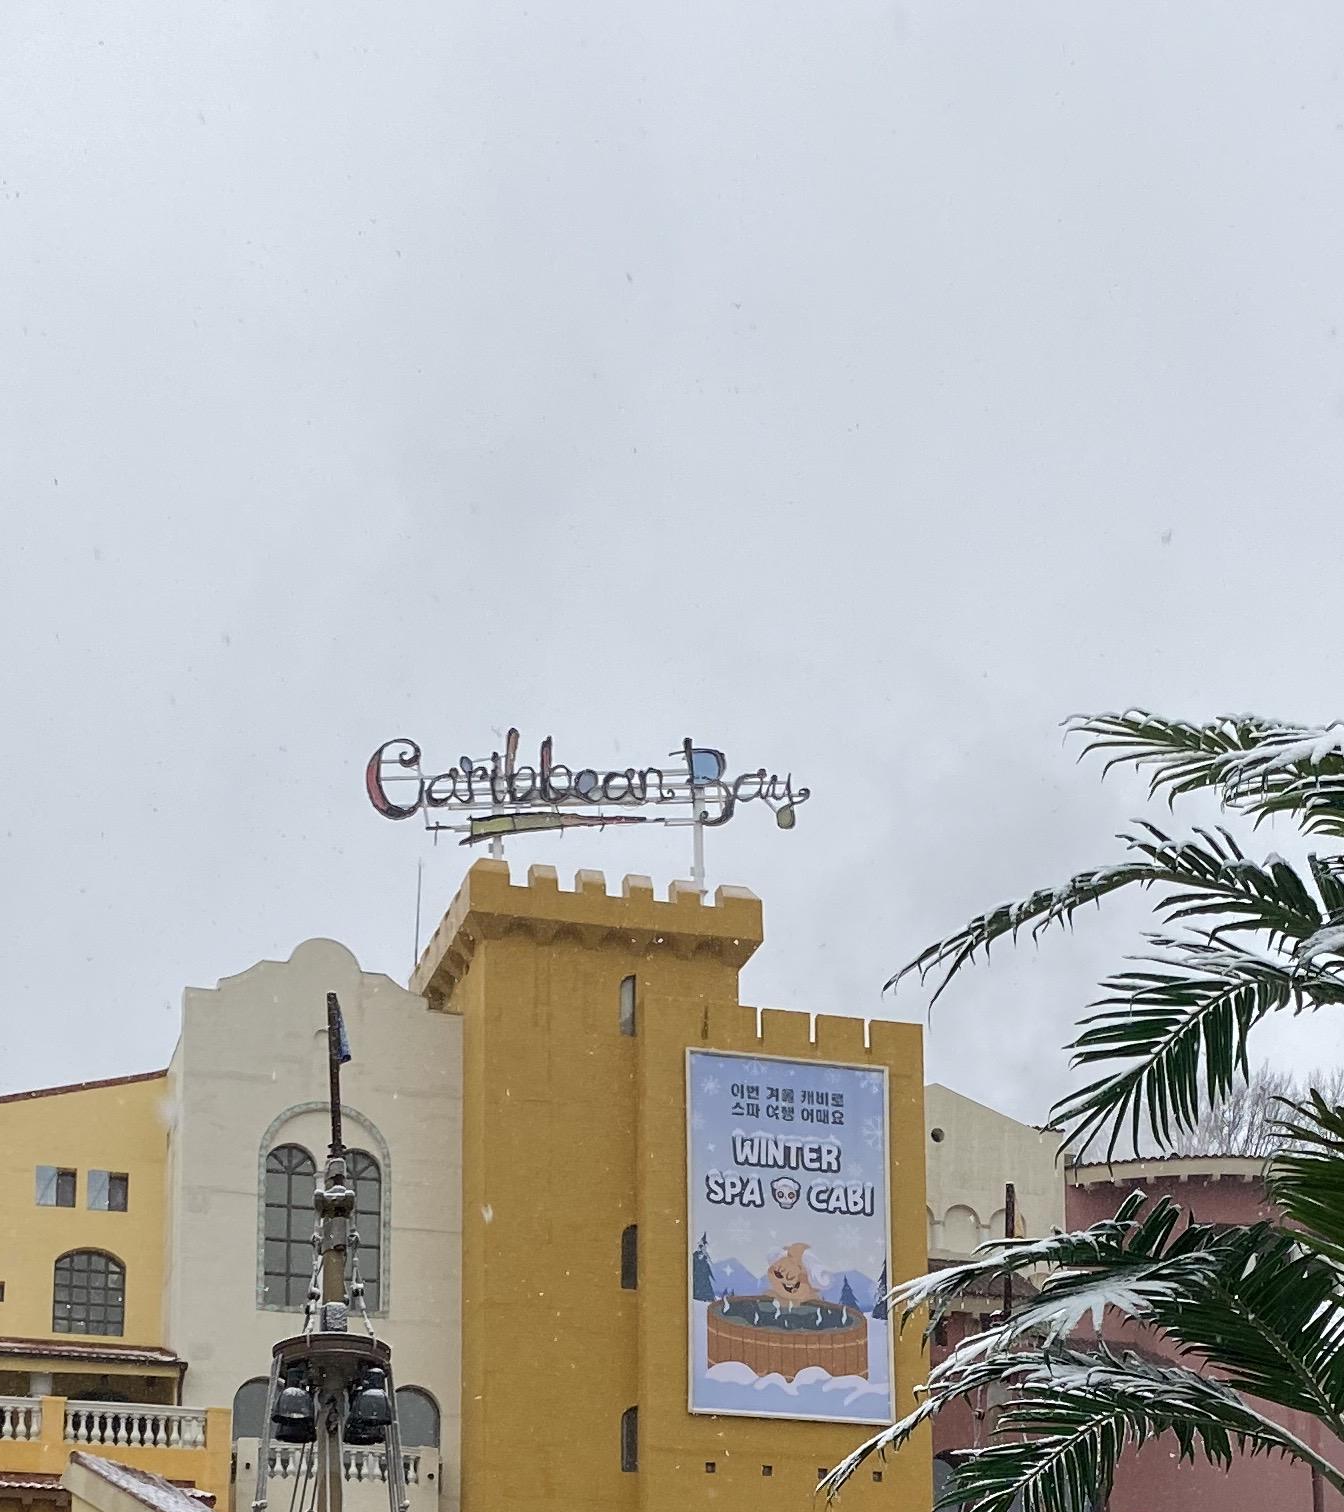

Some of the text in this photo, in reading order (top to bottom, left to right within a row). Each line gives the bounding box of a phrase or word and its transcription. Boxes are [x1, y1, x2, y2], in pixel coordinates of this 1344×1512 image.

[366, 727, 811, 829] Caribbean Bay
[731, 1083, 844, 1107] 이번 겨울 캐비로
[731, 1102, 844, 1125] 스파 여행 어때요
[731, 1132, 841, 1173] WINTER
[705, 1168, 875, 1216] SPA CABI
